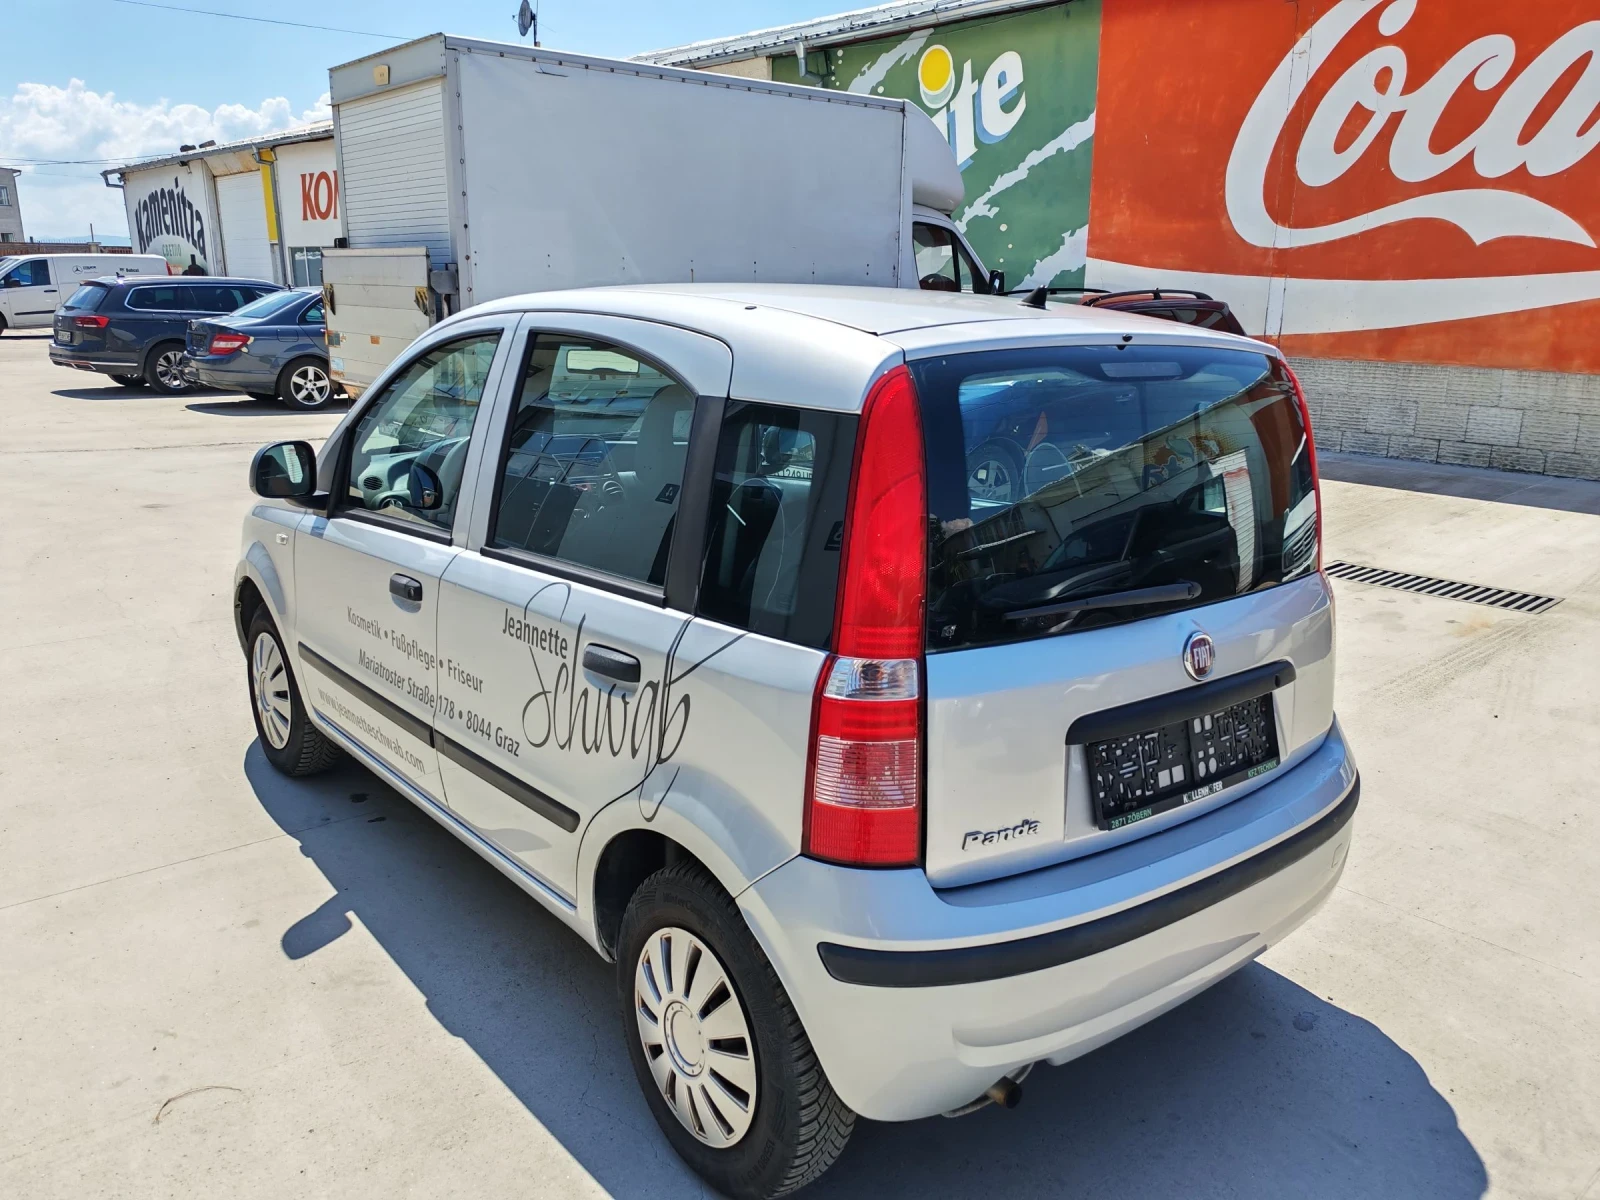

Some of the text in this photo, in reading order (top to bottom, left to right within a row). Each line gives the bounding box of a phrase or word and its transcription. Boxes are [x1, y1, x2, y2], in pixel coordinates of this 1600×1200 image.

[1225, 0, 1600, 249] Coca
[135, 176, 208, 263] Kamenitza
[347, 606, 483, 693] Kosmetik Fußpflege Friseur
[502, 608, 568, 660] Jeannette
[1193, 645, 1210, 669] FIAT
[317, 687, 426, 775] www.jeannetteschwab.com
[358, 648, 520, 757] Mariatroster Straße 178 8044 Graz
[522, 582, 750, 822] Schwab
[962, 819, 1041, 851] Panda
[1111, 817, 1126, 829] 2871
